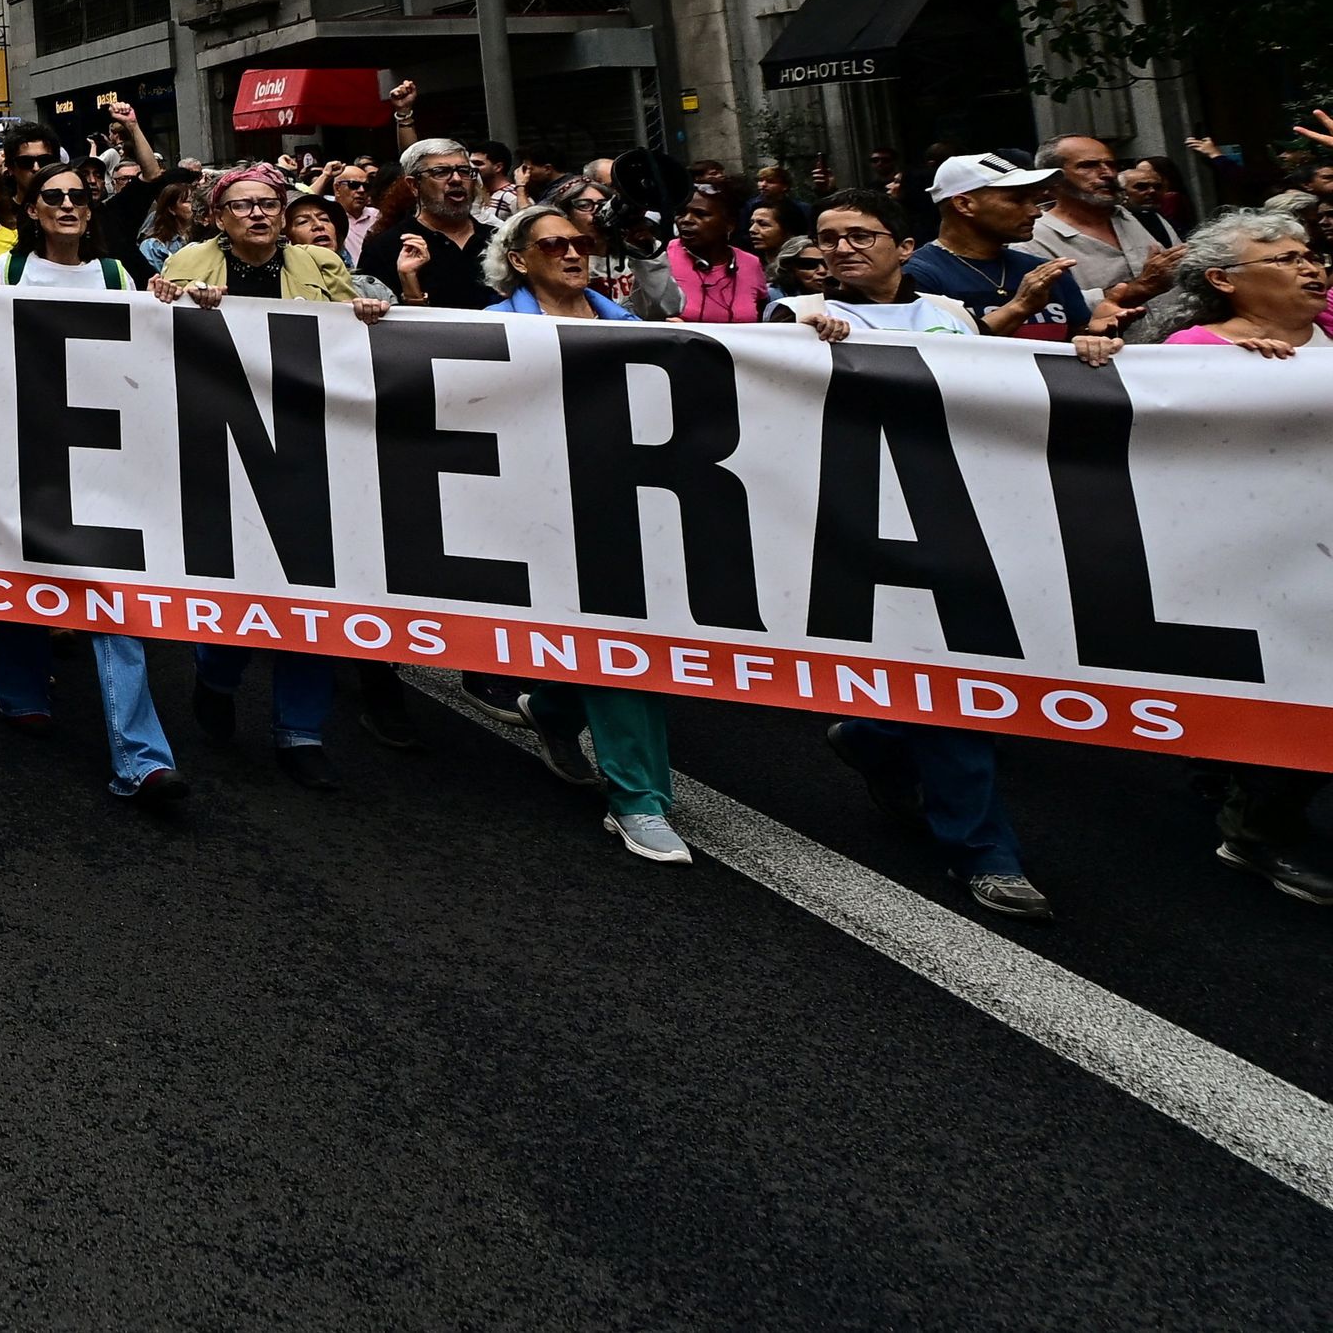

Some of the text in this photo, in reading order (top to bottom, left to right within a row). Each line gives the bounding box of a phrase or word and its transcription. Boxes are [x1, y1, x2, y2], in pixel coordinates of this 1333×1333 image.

[55, 91, 118, 114] beata pasta
[494, 628, 1184, 740] INDEFINIDOS
